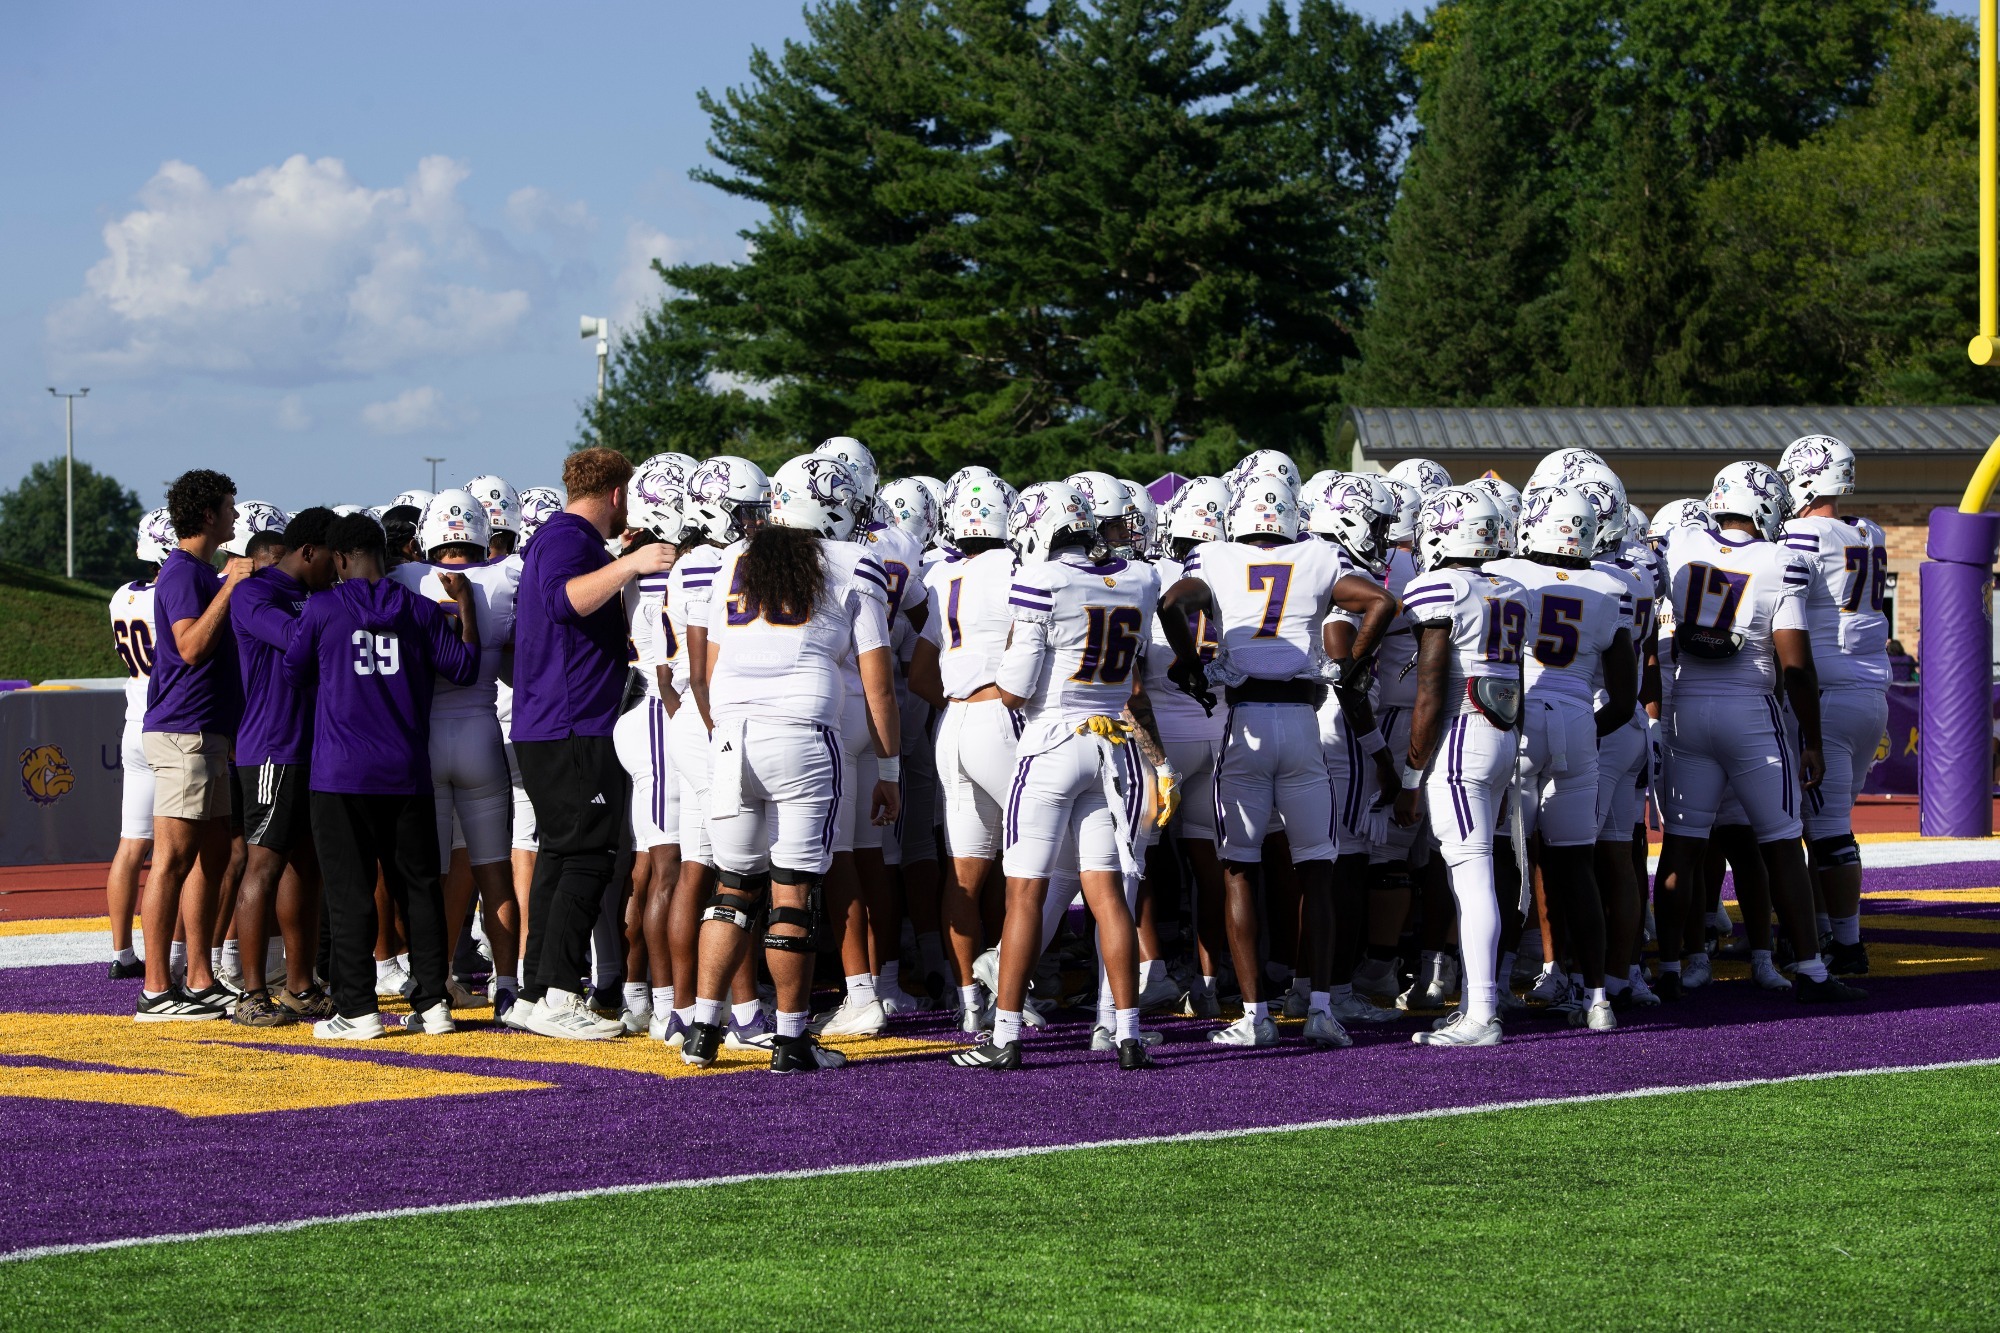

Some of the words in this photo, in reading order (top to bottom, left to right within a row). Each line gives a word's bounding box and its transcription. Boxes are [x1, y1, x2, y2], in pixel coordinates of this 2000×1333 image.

[443, 532, 473, 542] E.C.I.
[963, 528, 992, 537] E.C.I.
[1255, 524, 1285, 534] E.C.I.
[1557, 546, 1584, 557] E.C.I.
[1246, 562, 1295, 639] 7
[1684, 562, 1753, 632] 17
[1841, 545, 1887, 613] 76
[947, 576, 963, 652] 1
[1067, 605, 1143, 686] 16
[1483, 596, 1528, 664] 13
[1533, 593, 1584, 668] 5
[112, 618, 155, 680] 60
[352, 629, 400, 676] 39
